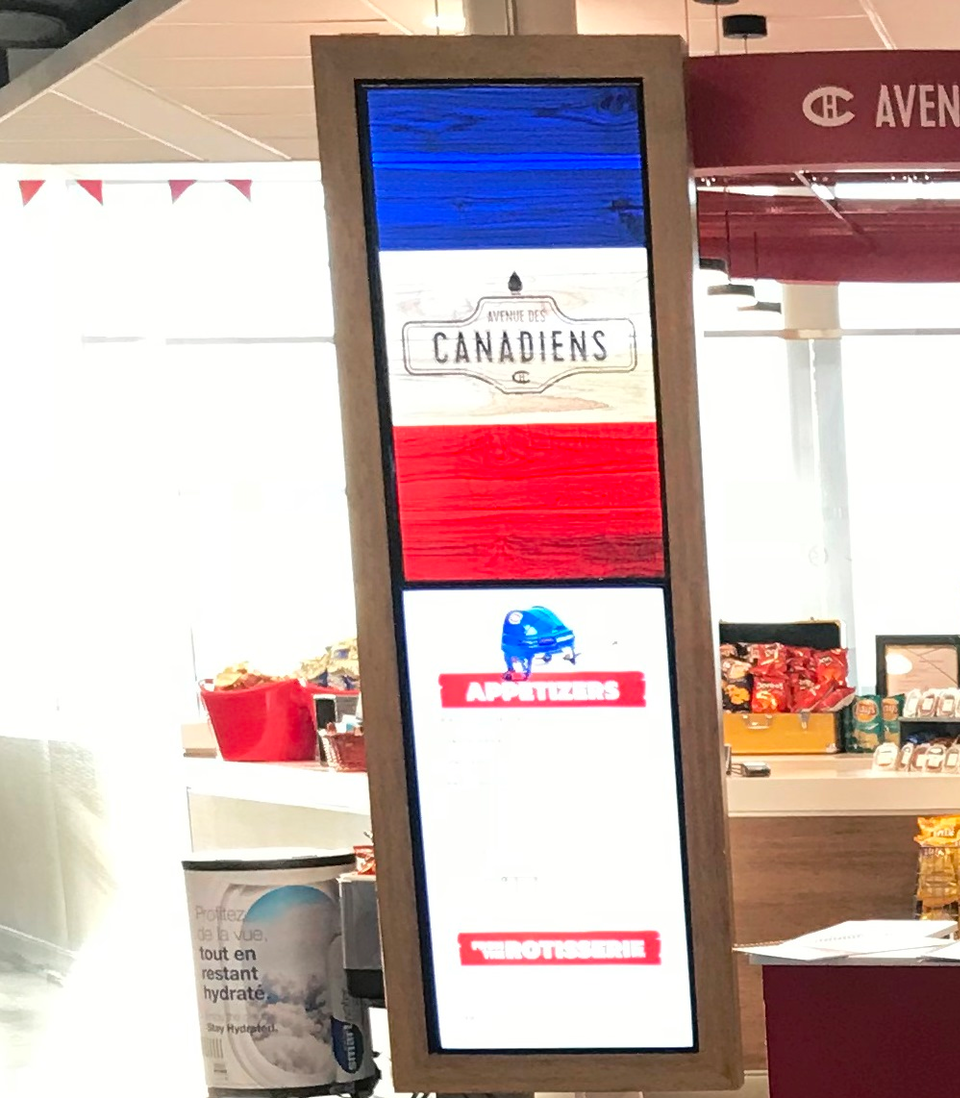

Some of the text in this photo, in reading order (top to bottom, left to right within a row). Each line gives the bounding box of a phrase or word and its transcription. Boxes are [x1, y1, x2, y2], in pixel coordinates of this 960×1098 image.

[487, 308, 546, 323] AVENUE DES
[432, 330, 608, 364] CANADIENS
[466, 681, 620, 702] APPETIZERS
[195, 904, 245, 924] Profitez
[197, 927, 213, 942] de
[199, 946, 257, 962] tout en
[504, 939, 646, 960] ROTISSERIE
[201, 966, 259, 982] restant
[203, 984, 271, 1003] hydraté.
